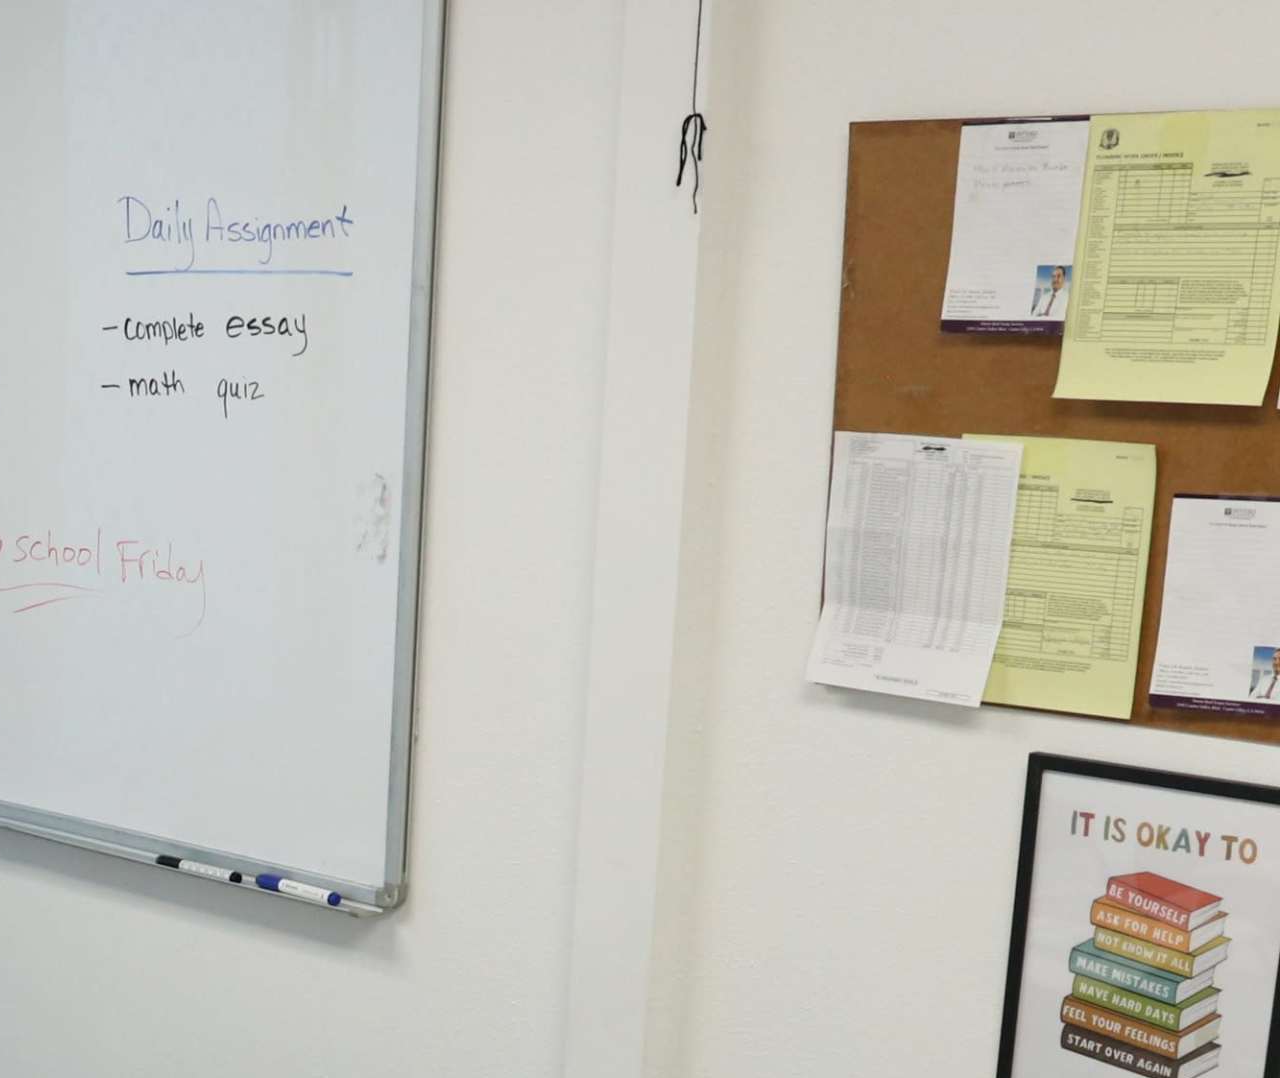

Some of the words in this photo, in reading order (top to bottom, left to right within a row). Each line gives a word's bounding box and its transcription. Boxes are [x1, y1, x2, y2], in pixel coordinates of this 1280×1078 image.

[117, 196, 195, 272] Daily
[205, 197, 354, 265] Assignment
[124, 313, 205, 345] complete
[226, 313, 307, 357] essay
[129, 370, 185, 397] math
[216, 376, 265, 419] quiz
[13, 528, 101, 574] school
[116, 540, 206, 639] Friday
[1070, 810, 1095, 837] IT
[1103, 815, 1127, 843] IS
[1137, 822, 1211, 857] OKAY
[1221, 834, 1258, 865] TO
[1109, 883, 1124, 900] BE
[1128, 890, 1189, 925] YOURSELF
[1096, 908, 1119, 925] ASK
[1124, 916, 1148, 936] FOR
[1152, 925, 1185, 947] HELP
[1096, 932, 1119, 950] NOT
[1122, 938, 1154, 961] KNOW
[1156, 947, 1167, 964] IT
[1170, 956, 1191, 973] ALL
[1076, 956, 1109, 977] MAKE
[1111, 965, 1171, 999] MISTAKES
[1078, 982, 1109, 1004] HAVE
[1111, 992, 1142, 1014] HARD
[1144, 1002, 1175, 1025] DAYS
[1063, 1004, 1087, 1023] FEEL
[1091, 1013, 1121, 1036] YOUR
[1124, 1024, 1176, 1053] FEELINGS
[1067, 1034, 1102, 1055] START
[1105, 1046, 1134, 1065] OVER
[1137, 1057, 1172, 1078] AGAIN
